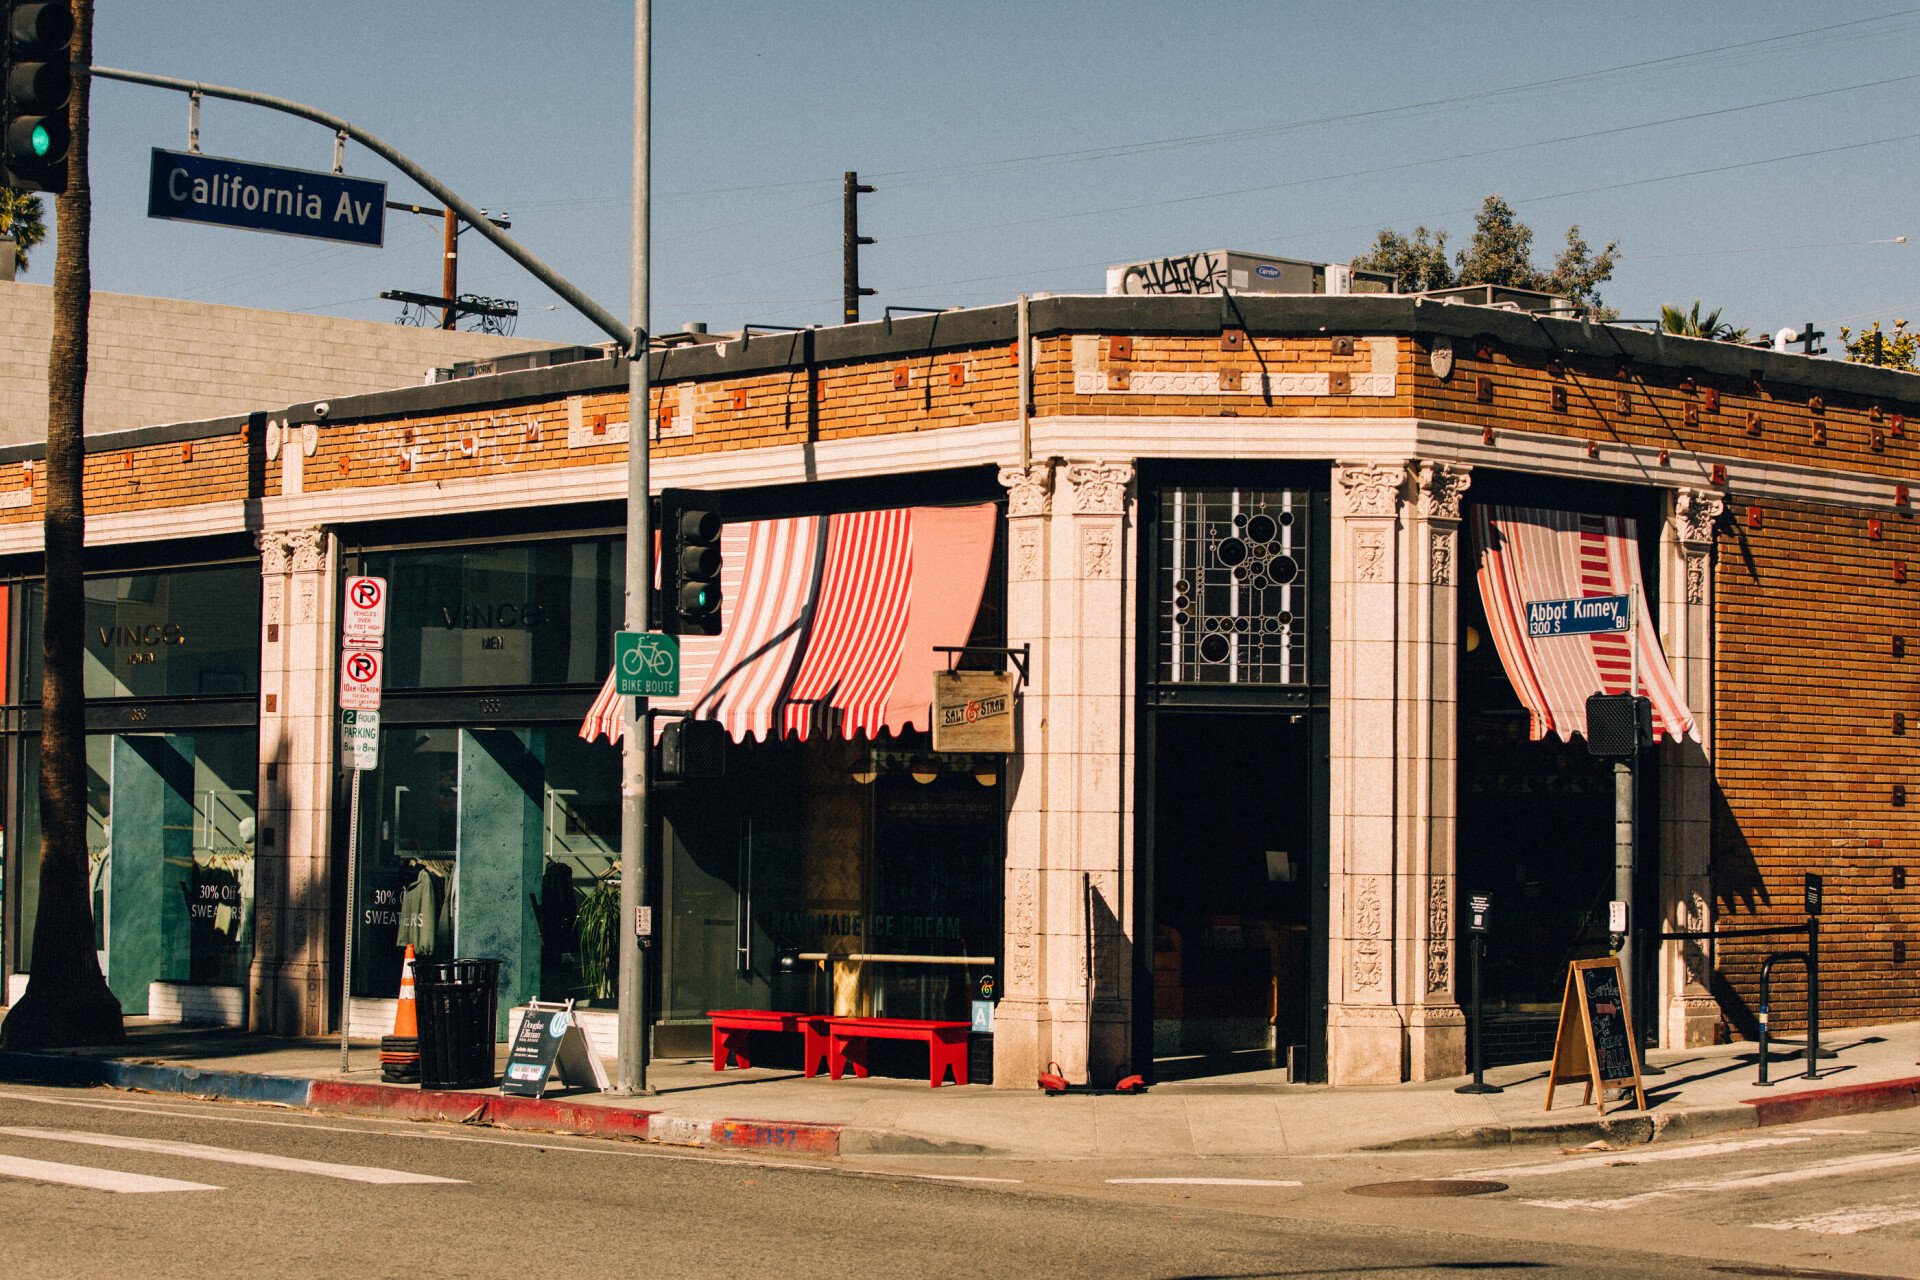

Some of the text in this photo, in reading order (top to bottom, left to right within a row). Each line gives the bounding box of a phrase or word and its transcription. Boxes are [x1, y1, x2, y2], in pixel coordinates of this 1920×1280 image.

[169, 168, 372, 226] California Av
[1257, 267, 1280, 278] Carrier
[474, 365, 492, 376] YORK
[1530, 600, 1618, 622] Abbot Kinney
[1529, 620, 1561, 635] 1300 S
[482, 636, 504, 650] MEN
[621, 679, 675, 694] BIKE ROUTE
[346, 711, 376, 724] 2 HOUR
[945, 698, 1006, 724] SALT & STRAW
[344, 727, 376, 739] PARKING
[343, 742, 355, 751] 8AM
[362, 743, 376, 752] 8PM
[200, 884, 237, 901] 30% Off
[374, 889, 397, 906] 30%
[364, 909, 424, 928] SWEATERS
[868, 914, 895, 937] ICE
[902, 916, 961, 940] CREAM
[974, 1008, 987, 1025] A
[524, 1020, 544, 1031] Douglas
[1598, 1048, 1629, 1070] FALL
